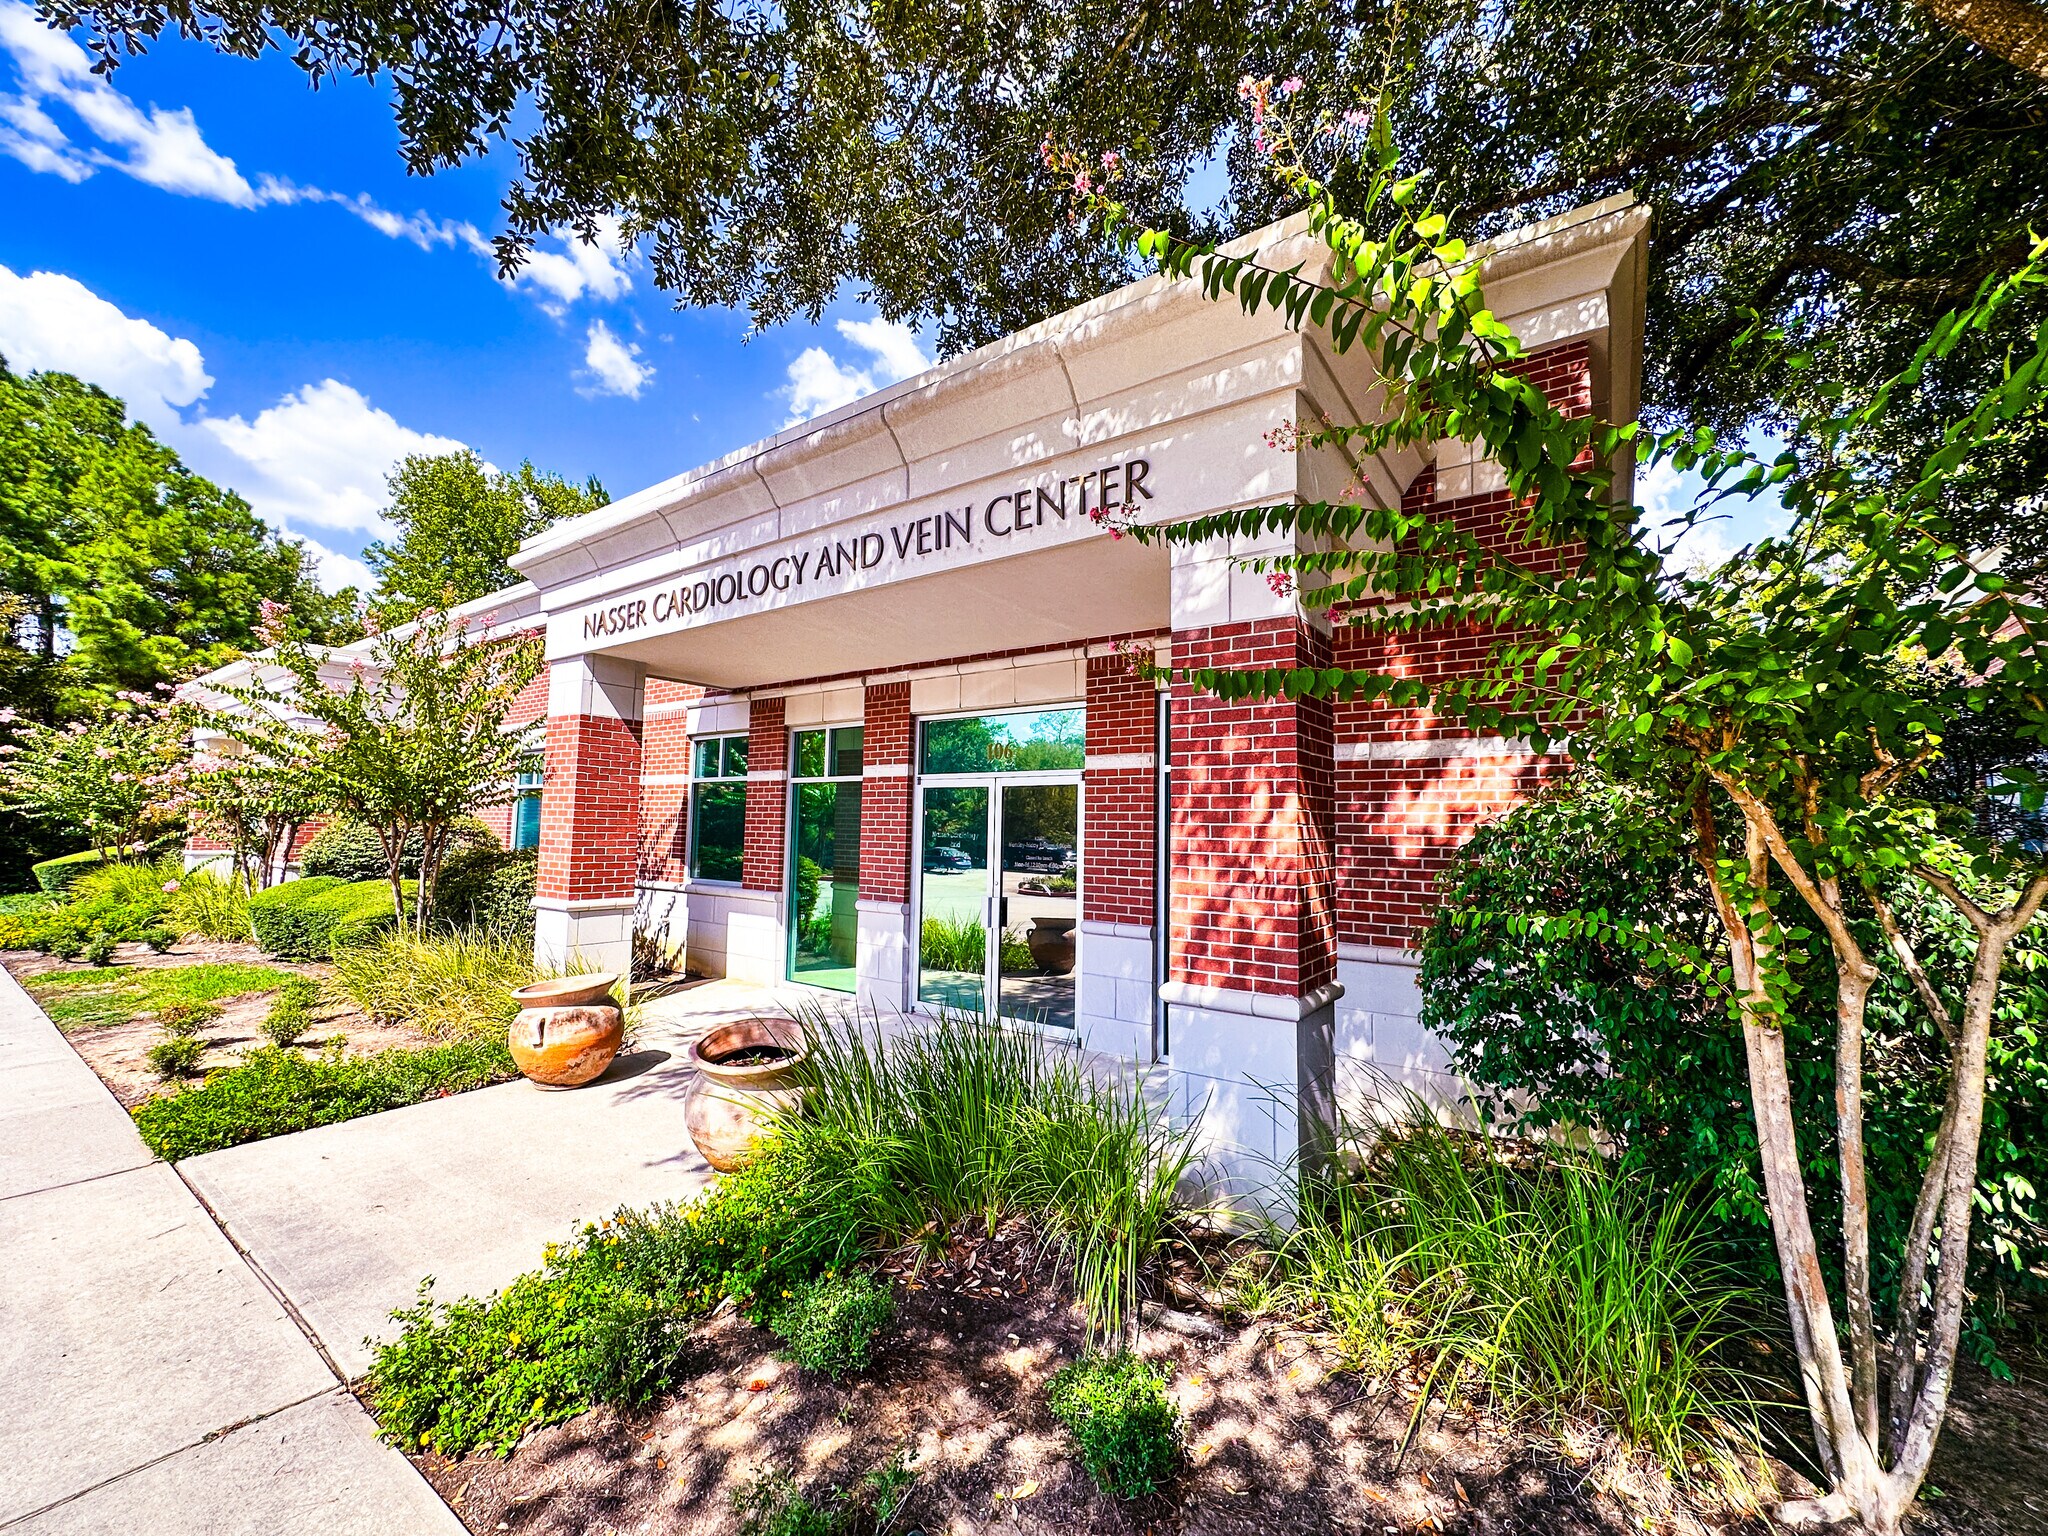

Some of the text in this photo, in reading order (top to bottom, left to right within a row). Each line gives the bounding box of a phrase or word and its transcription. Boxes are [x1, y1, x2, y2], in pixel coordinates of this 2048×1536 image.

[584, 459, 1154, 641] NASSER CARDIOLOGY AND VEIN CENTER
[986, 742, 1014, 762] 106
